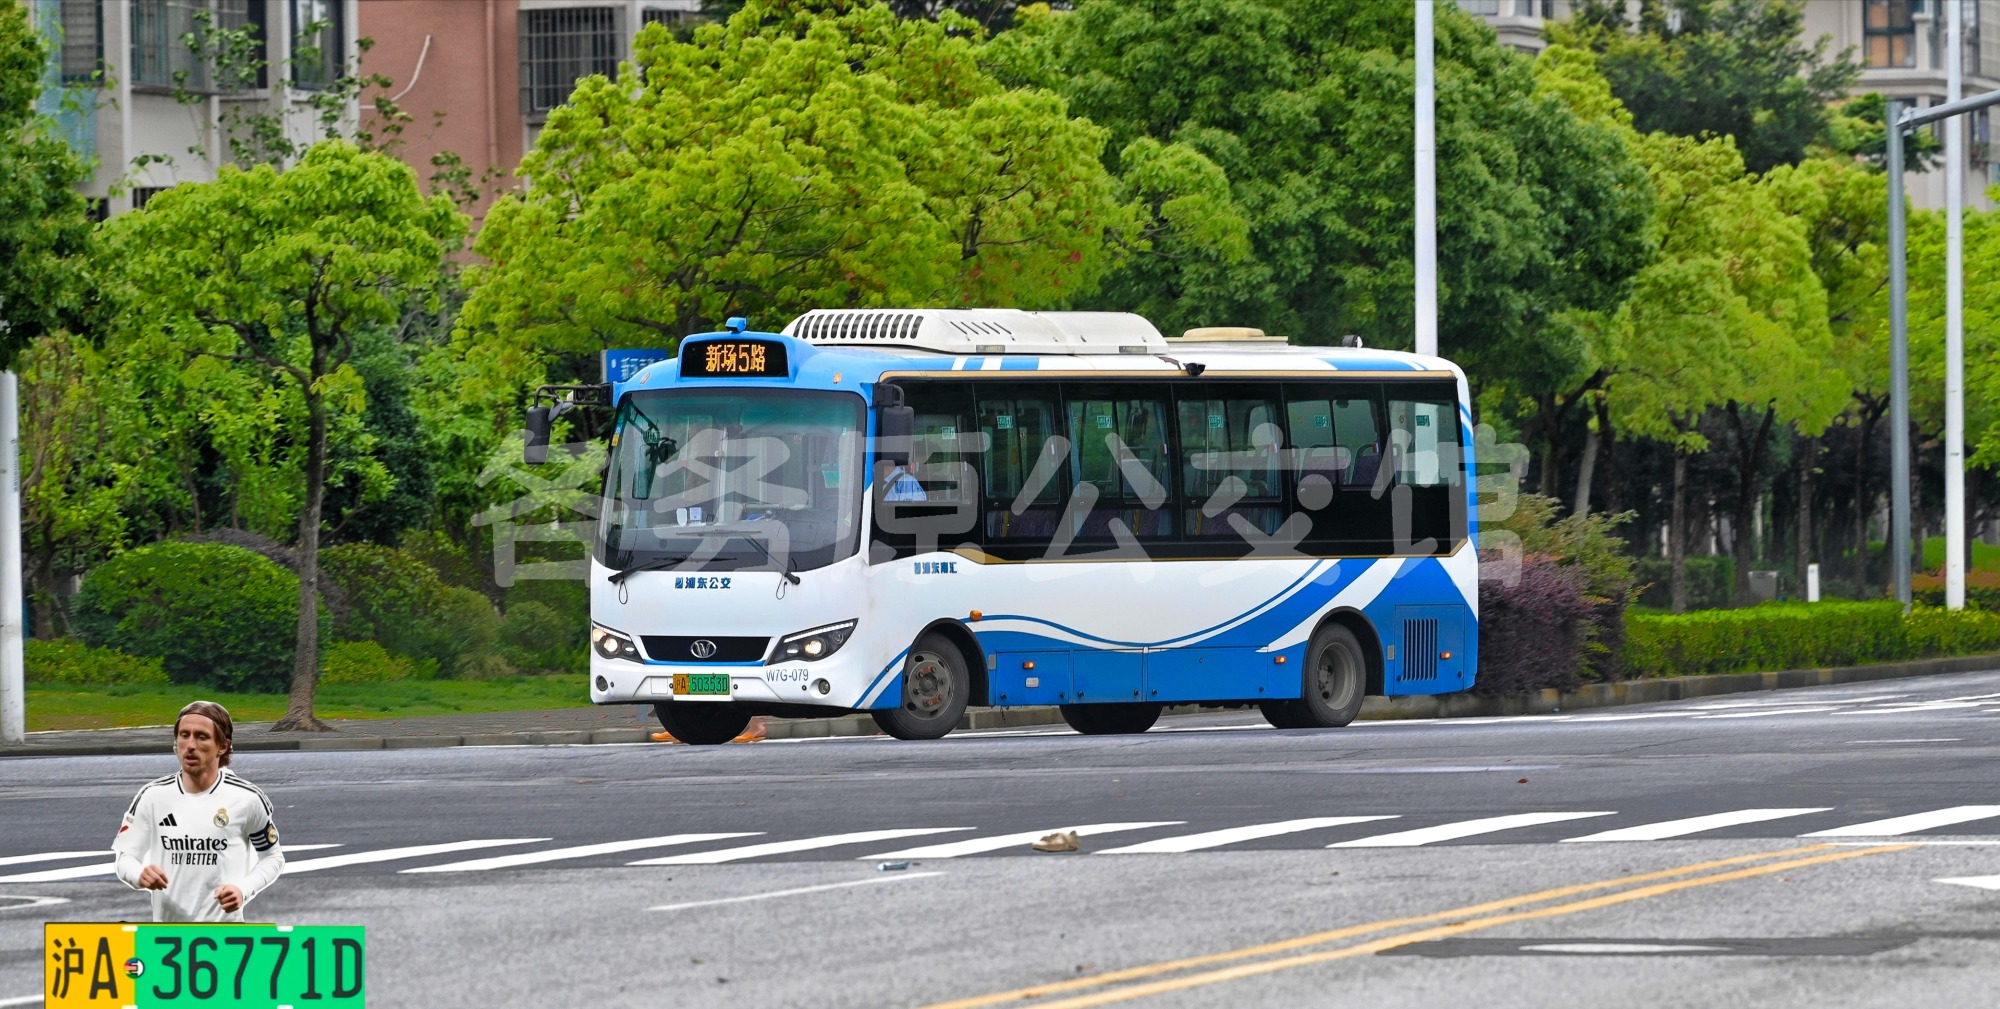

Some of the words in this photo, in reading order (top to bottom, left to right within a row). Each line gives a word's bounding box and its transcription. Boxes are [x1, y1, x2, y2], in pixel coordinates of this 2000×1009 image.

[706, 344, 766, 372] 新场5路
[685, 577, 731, 589] 浦东公交
[766, 669, 809, 682] W7G-079
[160, 834, 228, 851] Emirates
[171, 853, 183, 865] FLY
[186, 853, 218, 865] BETTER
